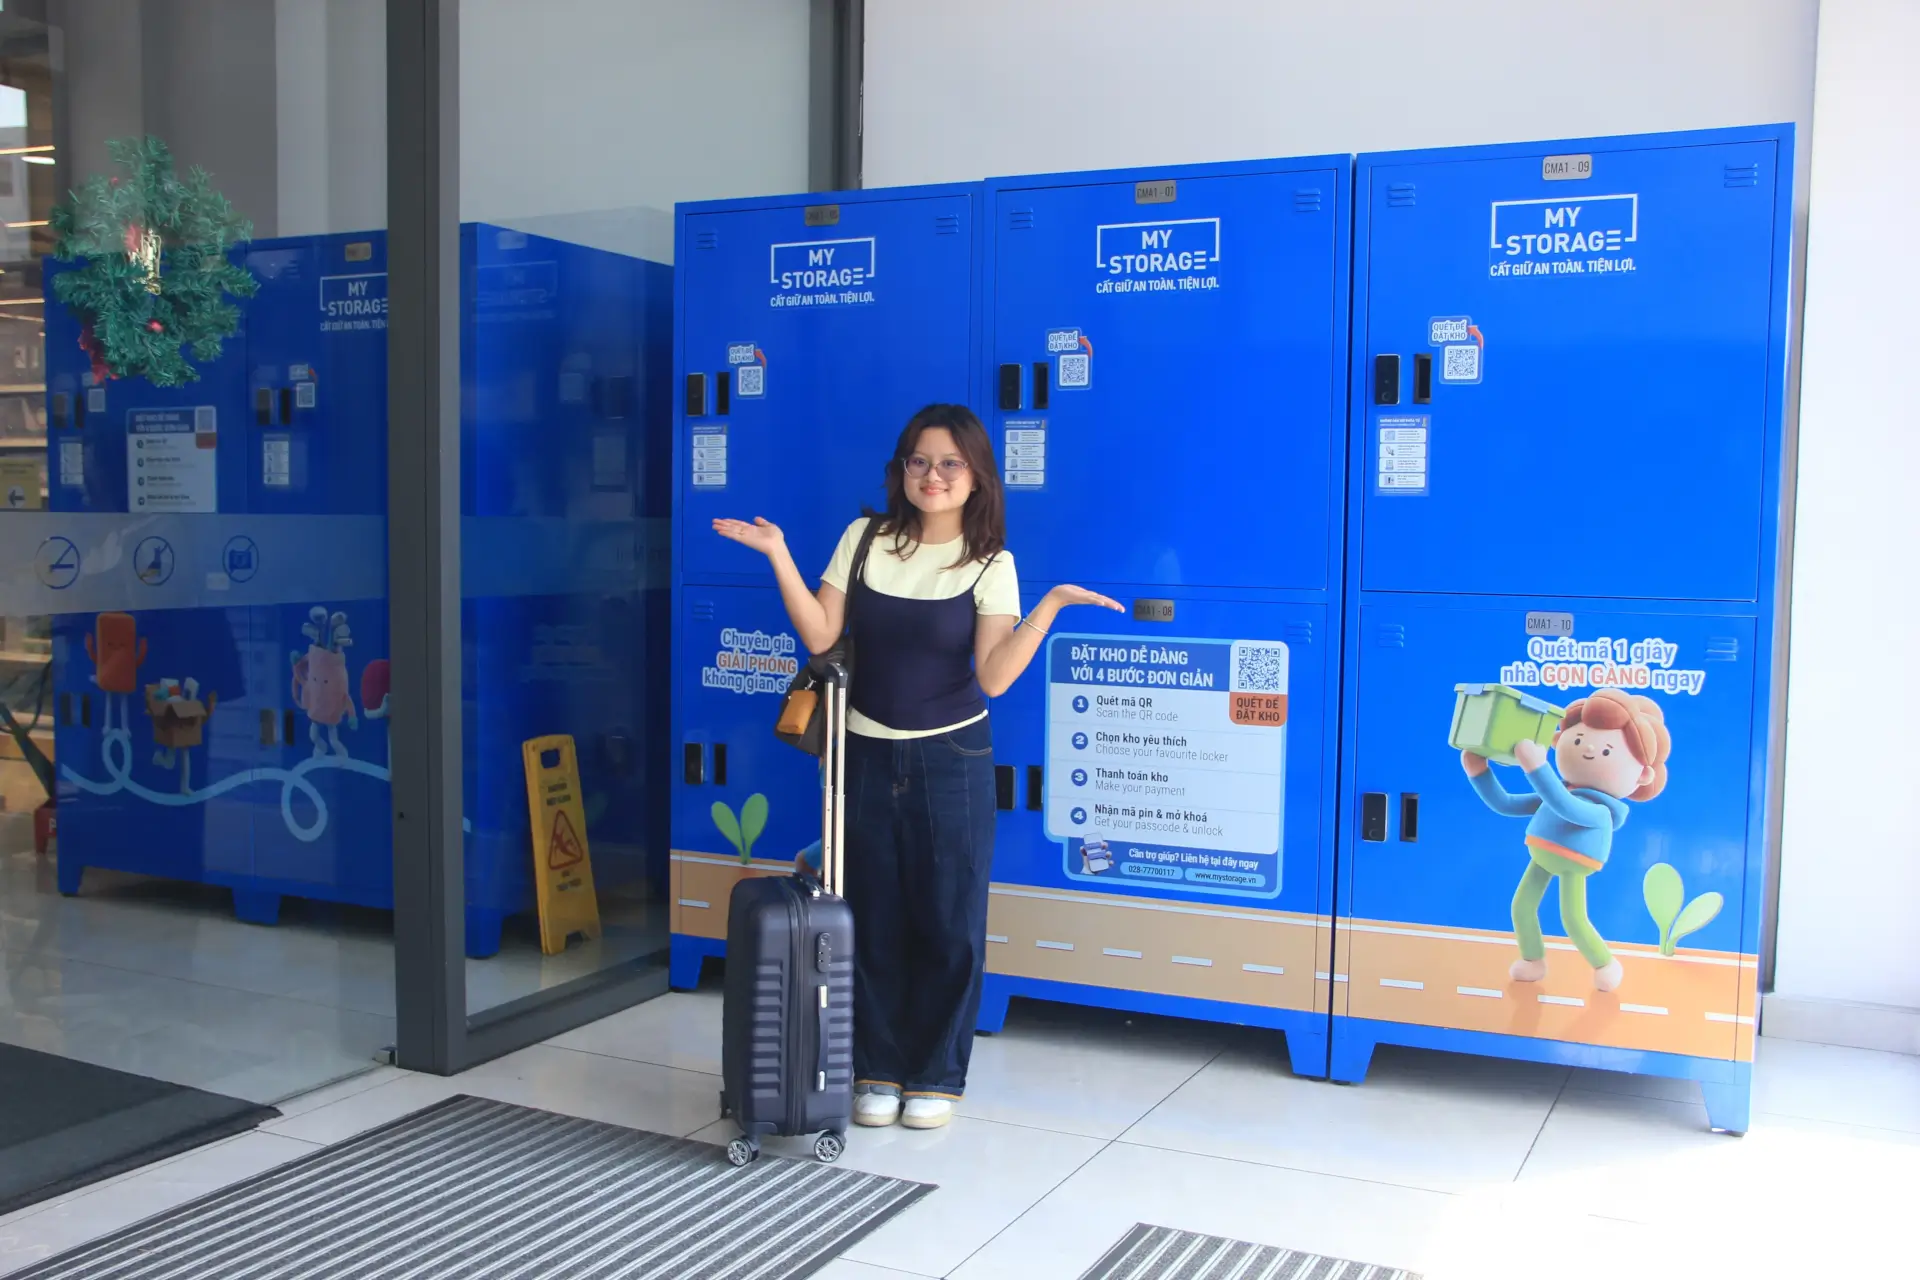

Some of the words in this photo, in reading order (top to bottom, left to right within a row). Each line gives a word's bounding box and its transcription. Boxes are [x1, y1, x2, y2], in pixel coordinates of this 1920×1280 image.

[1544, 162, 1568, 174] CMA1
[1577, 161, 1590, 173] 09
[1136, 188, 1157, 199] CMA1
[1165, 186, 1174, 197] 07
[1545, 206, 1581, 229] MY
[1141, 229, 1173, 250] MY
[1506, 230, 1621, 256] STORAGE
[808, 248, 835, 267] MY
[1109, 251, 1206, 275] STORAGE
[1490, 260, 1511, 277] CẤT
[1512, 260, 1534, 275] GIỮ
[1534, 262, 1550, 275] AN
[1552, 258, 1585, 274] TOÀN.
[1587, 257, 1613, 274] TIỆN
[1614, 257, 1636, 274] LỢI.
[781, 267, 864, 290] STORAGE
[1096, 279, 1114, 294] CẤT
[1115, 278, 1133, 293] GIỮ
[1133, 280, 1147, 292] AN
[1148, 277, 1176, 291] TOÀN.
[1178, 276, 1200, 291] TIỆN
[348, 281, 368, 297] MY
[770, 293, 785, 307] CẤT
[802, 294, 813, 306] AN
[814, 291, 838, 305] TOÀN.
[839, 291, 859, 304] TIỆN
[1433, 321, 1453, 331] QUÉT
[1449, 332, 1466, 340] KHO
[1162, 605, 1173, 616] 08
[1527, 617, 1551, 630] CMA1
[1561, 619, 1571, 631] 10
[722, 629, 770, 650] Chuyên
[773, 633, 794, 653] gia
[718, 649, 746, 668] GIẢI
[749, 654, 797, 673] PHÓNG
[1071, 644, 1097, 665] ĐẶT
[1099, 647, 1128, 662] KHO
[1130, 645, 1148, 664] DỄ
[1151, 646, 1188, 665] DÀNG
[1530, 638, 1577, 660] Quét
[1580, 640, 1609, 659] mã
[1614, 641, 1625, 661] 1
[1632, 639, 1676, 666] giây
[704, 668, 743, 691] không
[747, 673, 774, 692] gian
[1070, 664, 1094, 681] VỚI
[1096, 667, 1105, 682] 4
[1107, 666, 1145, 684] BƯỚC
[1147, 671, 1177, 686] ĐƠN
[1179, 670, 1214, 688] GIẢN
[1503, 663, 1537, 684] nhà
[1543, 665, 1585, 688] GỌN
[1591, 661, 1648, 686] GÀNG
[1654, 670, 1702, 692] ngay
[1096, 695, 1119, 708] Quét
[1121, 696, 1136, 707] mã
[1138, 698, 1153, 710] QR
[1236, 695, 1264, 710] QUÉT
[1265, 695, 1280, 709] ĐỂ
[1096, 708, 1119, 719] Scan
[1121, 709, 1136, 720] the
[1138, 710, 1153, 722] QR
[1155, 711, 1179, 722] code
[1236, 709, 1257, 724] ĐẶT
[1258, 711, 1280, 722] KHO
[1096, 731, 1120, 744] Chọn
[1122, 733, 1140, 744] kho
[1143, 735, 1160, 747] yêu
[1163, 735, 1187, 747] thích
[1096, 743, 1131, 756] Choose
[1133, 747, 1153, 759] your
[1155, 747, 1198, 761] favourite
[1199, 749, 1229, 763] locker
[1096, 767, 1125, 780] Thanh
[1127, 770, 1148, 782] toán
[1150, 771, 1169, 783] kho
[1095, 780, 1120, 792] Make
[1122, 783, 1142, 795] your
[1144, 785, 1186, 798] payment
[1094, 803, 1119, 817] Nhận
[1121, 806, 1136, 817] mã
[1138, 807, 1154, 821] pin
[1156, 809, 1163, 820] &
[1165, 808, 1182, 820] mở
[1183, 810, 1208, 823] khoá
[1094, 815, 1110, 827] Get
[1112, 819, 1133, 831] your
[1135, 819, 1181, 834] passcode
[1182, 823, 1189, 834] &
[1191, 825, 1224, 837] unlock
[1128, 848, 1145, 859] Cần
[1146, 850, 1157, 862] trợ
[1158, 851, 1180, 864] giúp?
[1181, 853, 1198, 864] Liên
[1199, 854, 1209, 867] hệ
[1210, 856, 1221, 868] tại
[1222, 856, 1238, 868] đây
[1238, 860, 1259, 871] ngay
[1128, 865, 1175, 877] 028-77700117
[1195, 871, 1257, 885] www.mystorage.vn
